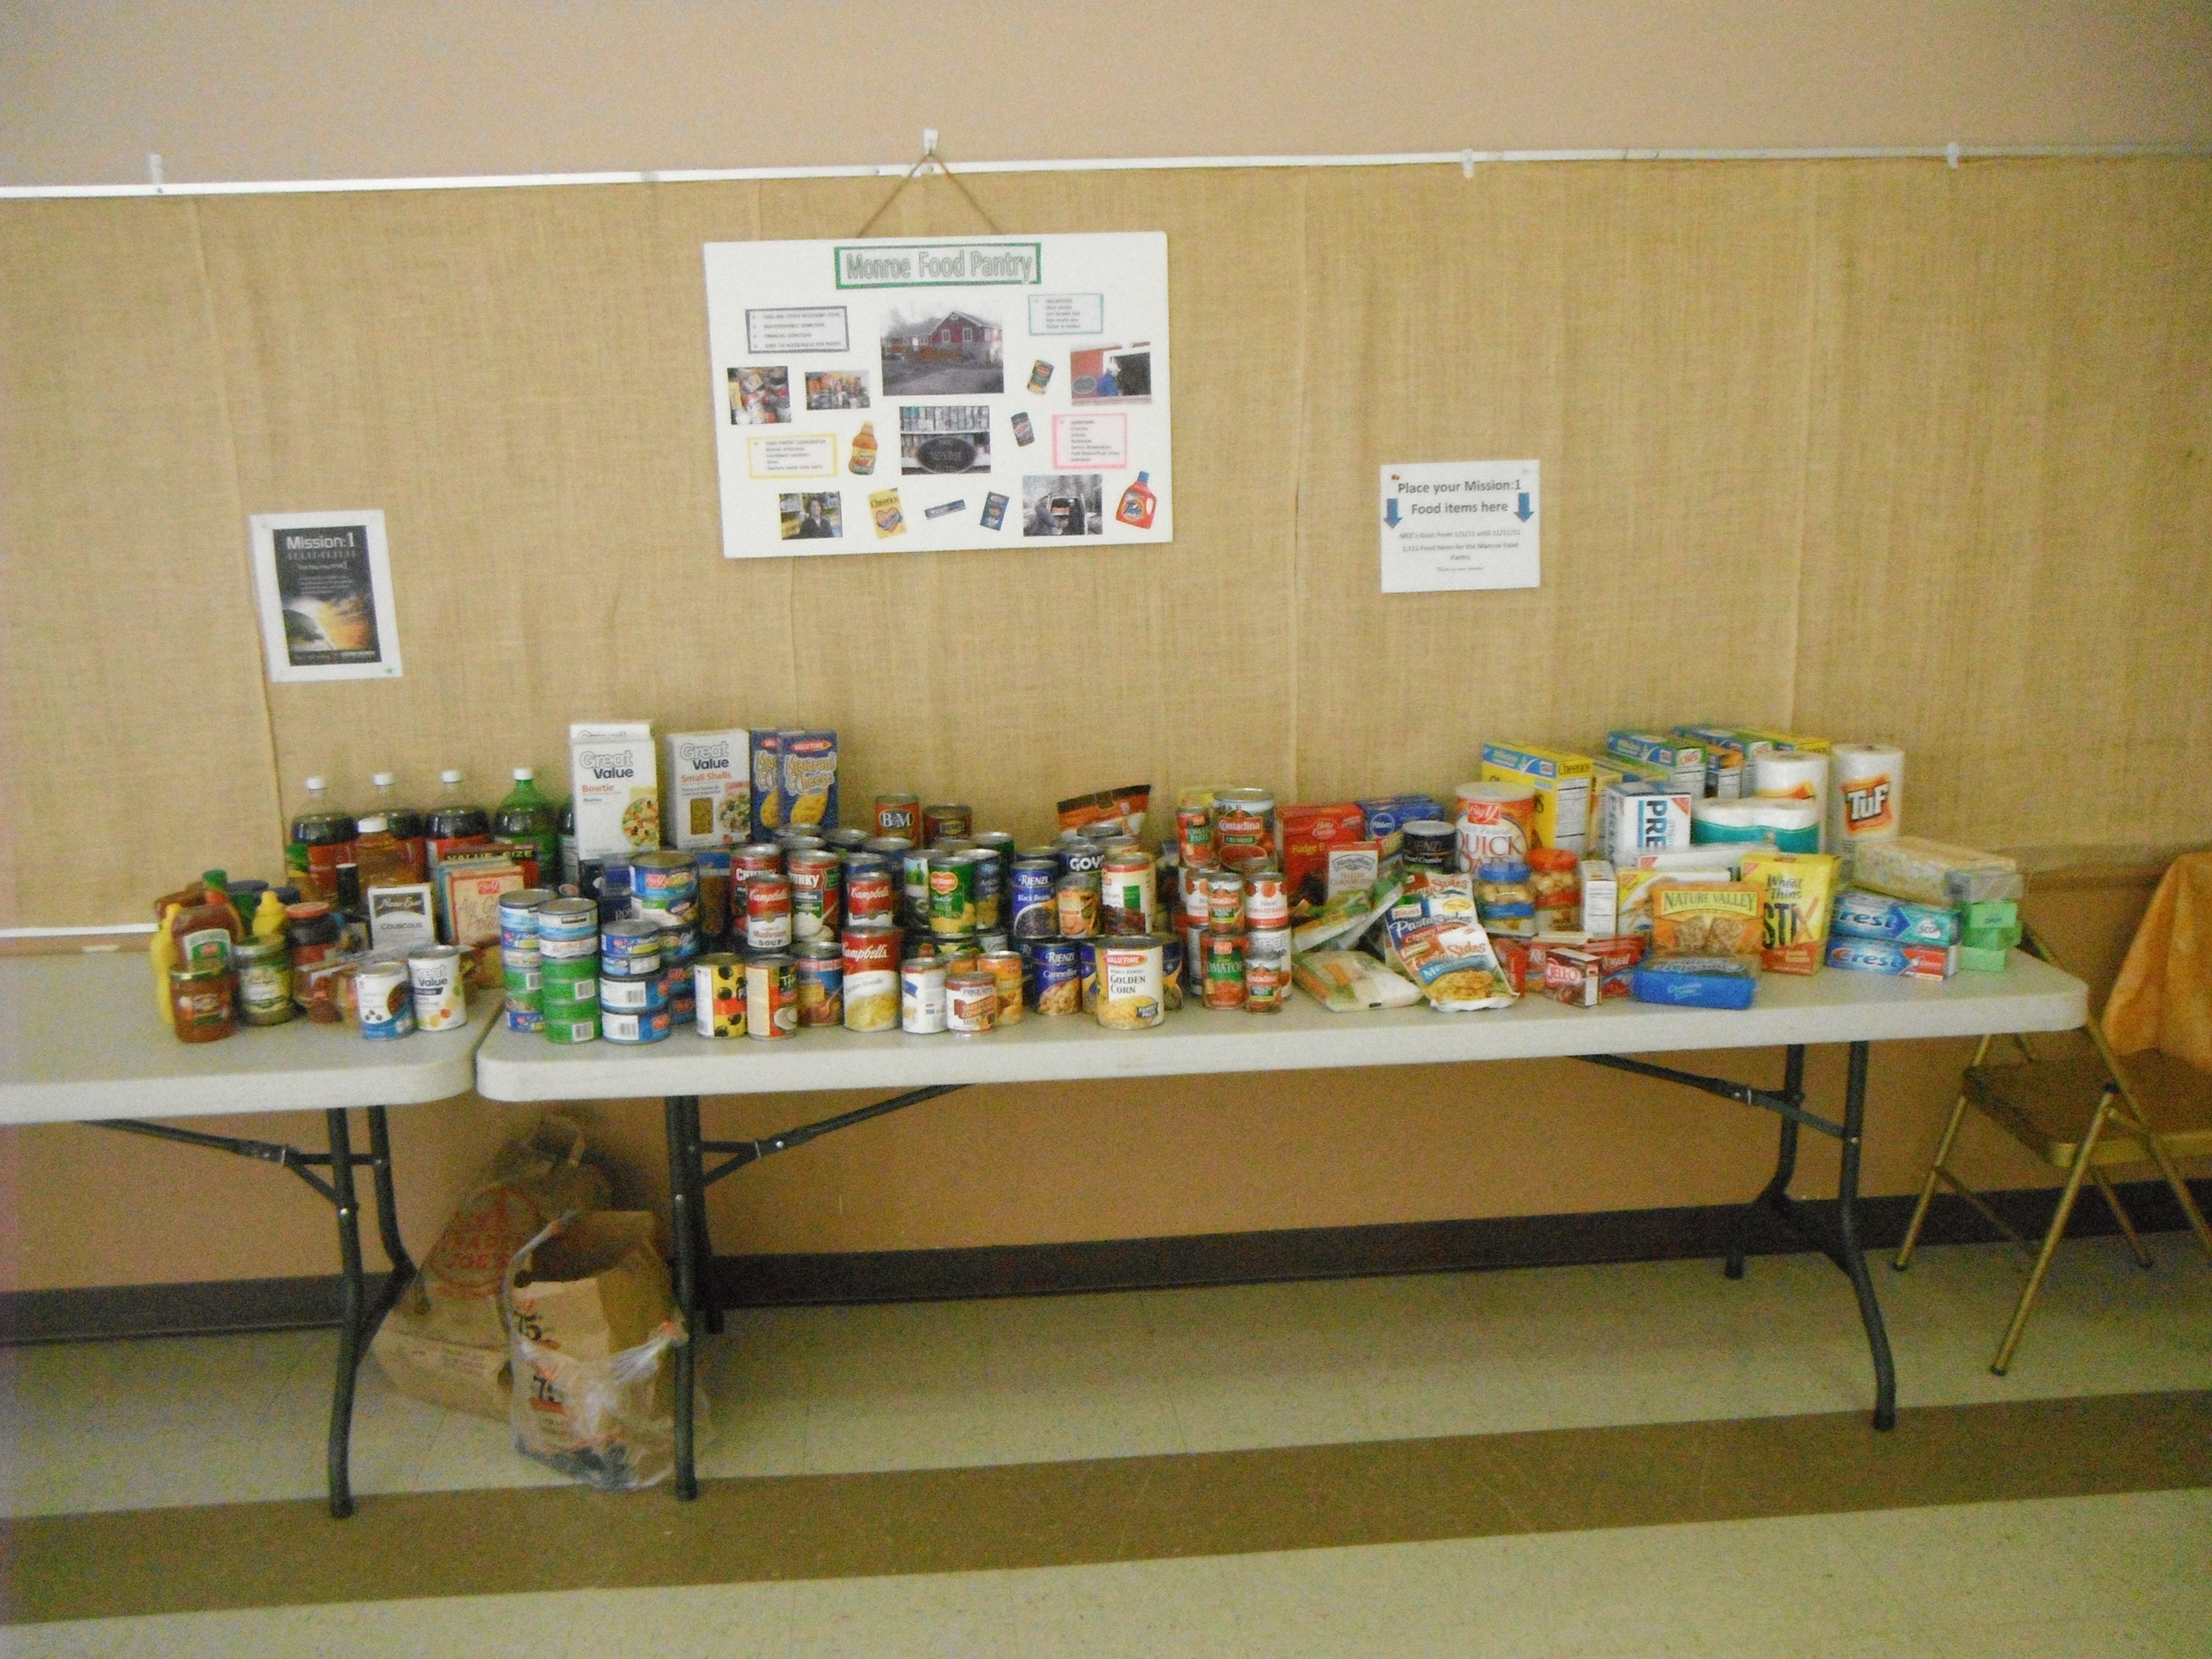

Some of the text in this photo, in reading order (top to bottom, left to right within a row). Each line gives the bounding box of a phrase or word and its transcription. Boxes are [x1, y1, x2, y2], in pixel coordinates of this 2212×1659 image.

[846, 250, 1032, 282] Monroe Food Pantry
[1398, 479, 1521, 495] Place your Mission:1
[1412, 501, 1508, 515] Food items here
[286, 531, 356, 550] Mission:1
[680, 741, 729, 761] Great
[580, 750, 633, 769] Great
[692, 758, 730, 771] Value
[593, 768, 634, 779] Value
[681, 771, 732, 783] Small Shells
[582, 783, 614, 793] Bowtie
[1219, 819, 1261, 832] Contadina
[1292, 845, 1317, 855] Fudge
[1663, 892, 1757, 911] NATURE VALLEY
[380, 921, 423, 930] Couscous
[1839, 910, 1899, 929] rest
[1045, 951, 1075, 965] RIENZI
[1832, 947, 1897, 968] Crest
[418, 977, 449, 987] Value
[1110, 974, 1146, 985] GOLDEN
[1110, 984, 1136, 994] CORN
